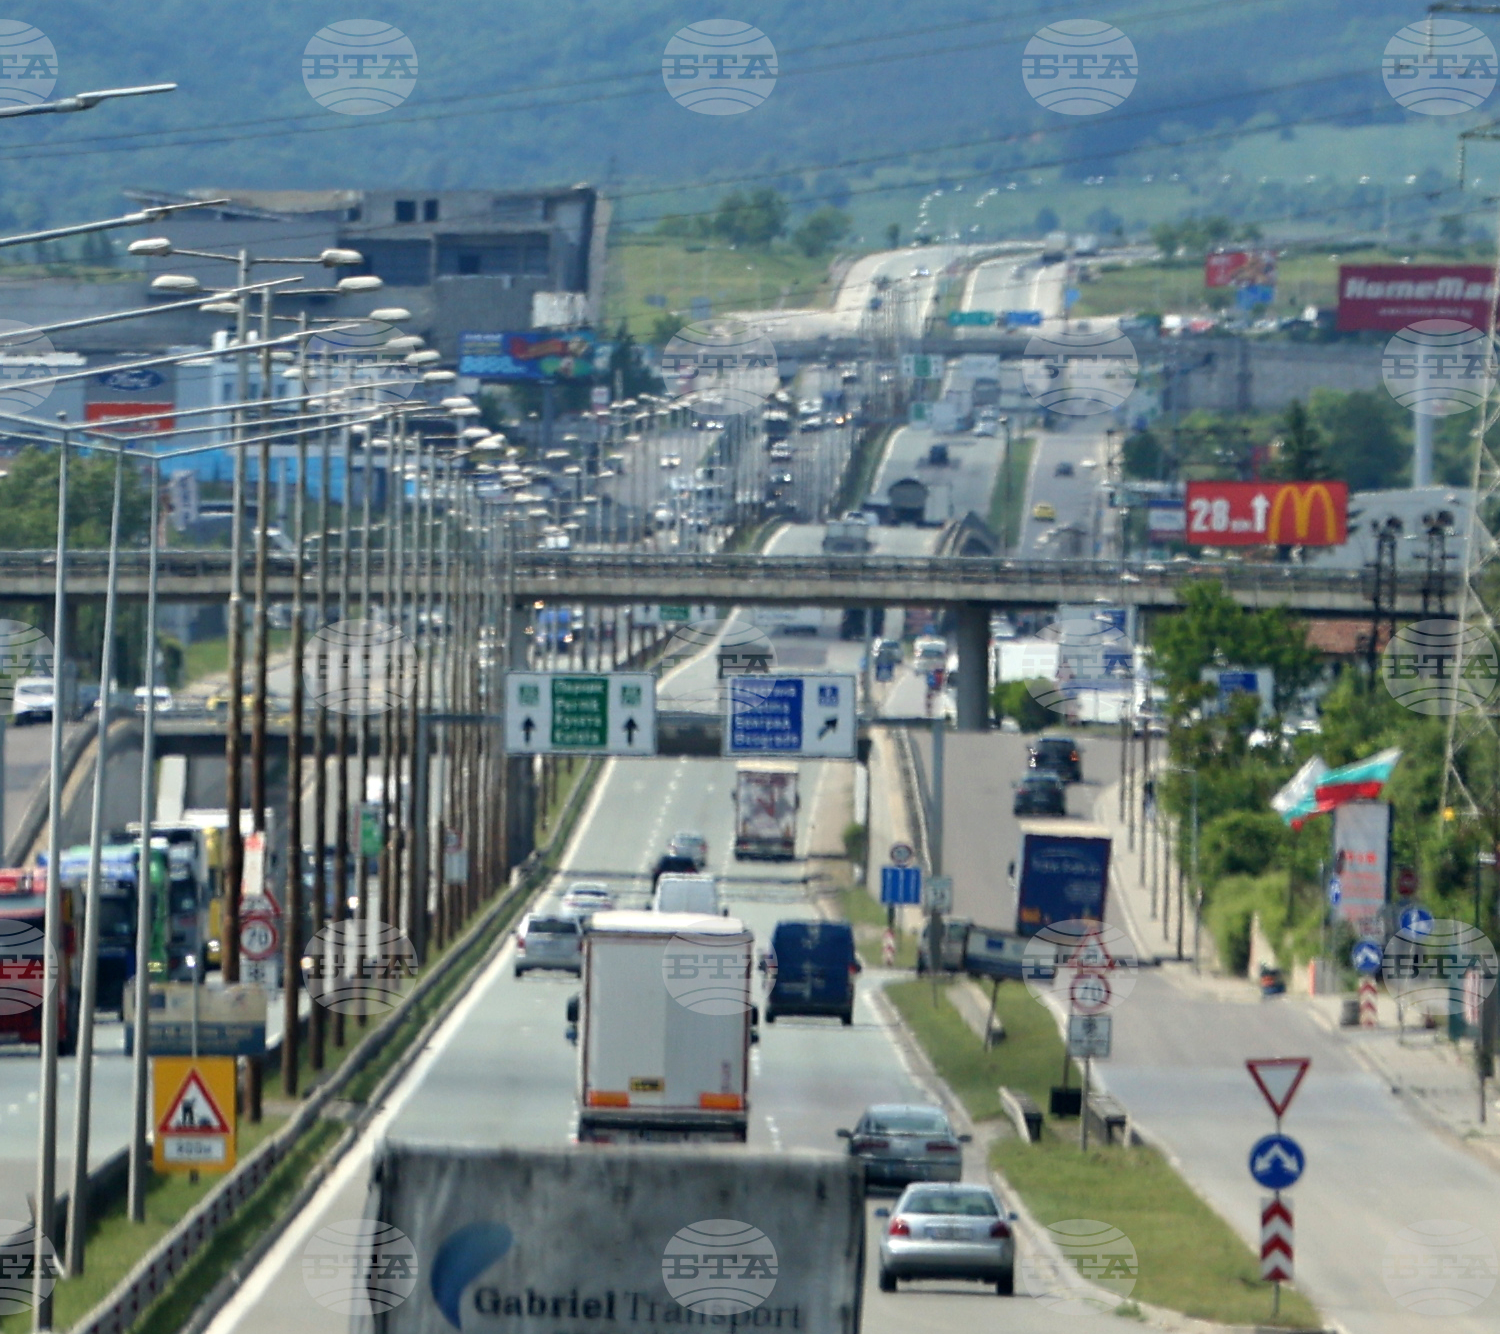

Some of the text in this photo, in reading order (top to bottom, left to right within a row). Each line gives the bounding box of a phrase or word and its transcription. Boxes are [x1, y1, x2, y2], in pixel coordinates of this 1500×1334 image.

[1189, 498, 1230, 533] 28
[474, 1286, 804, 1334] Gabriel Transport
